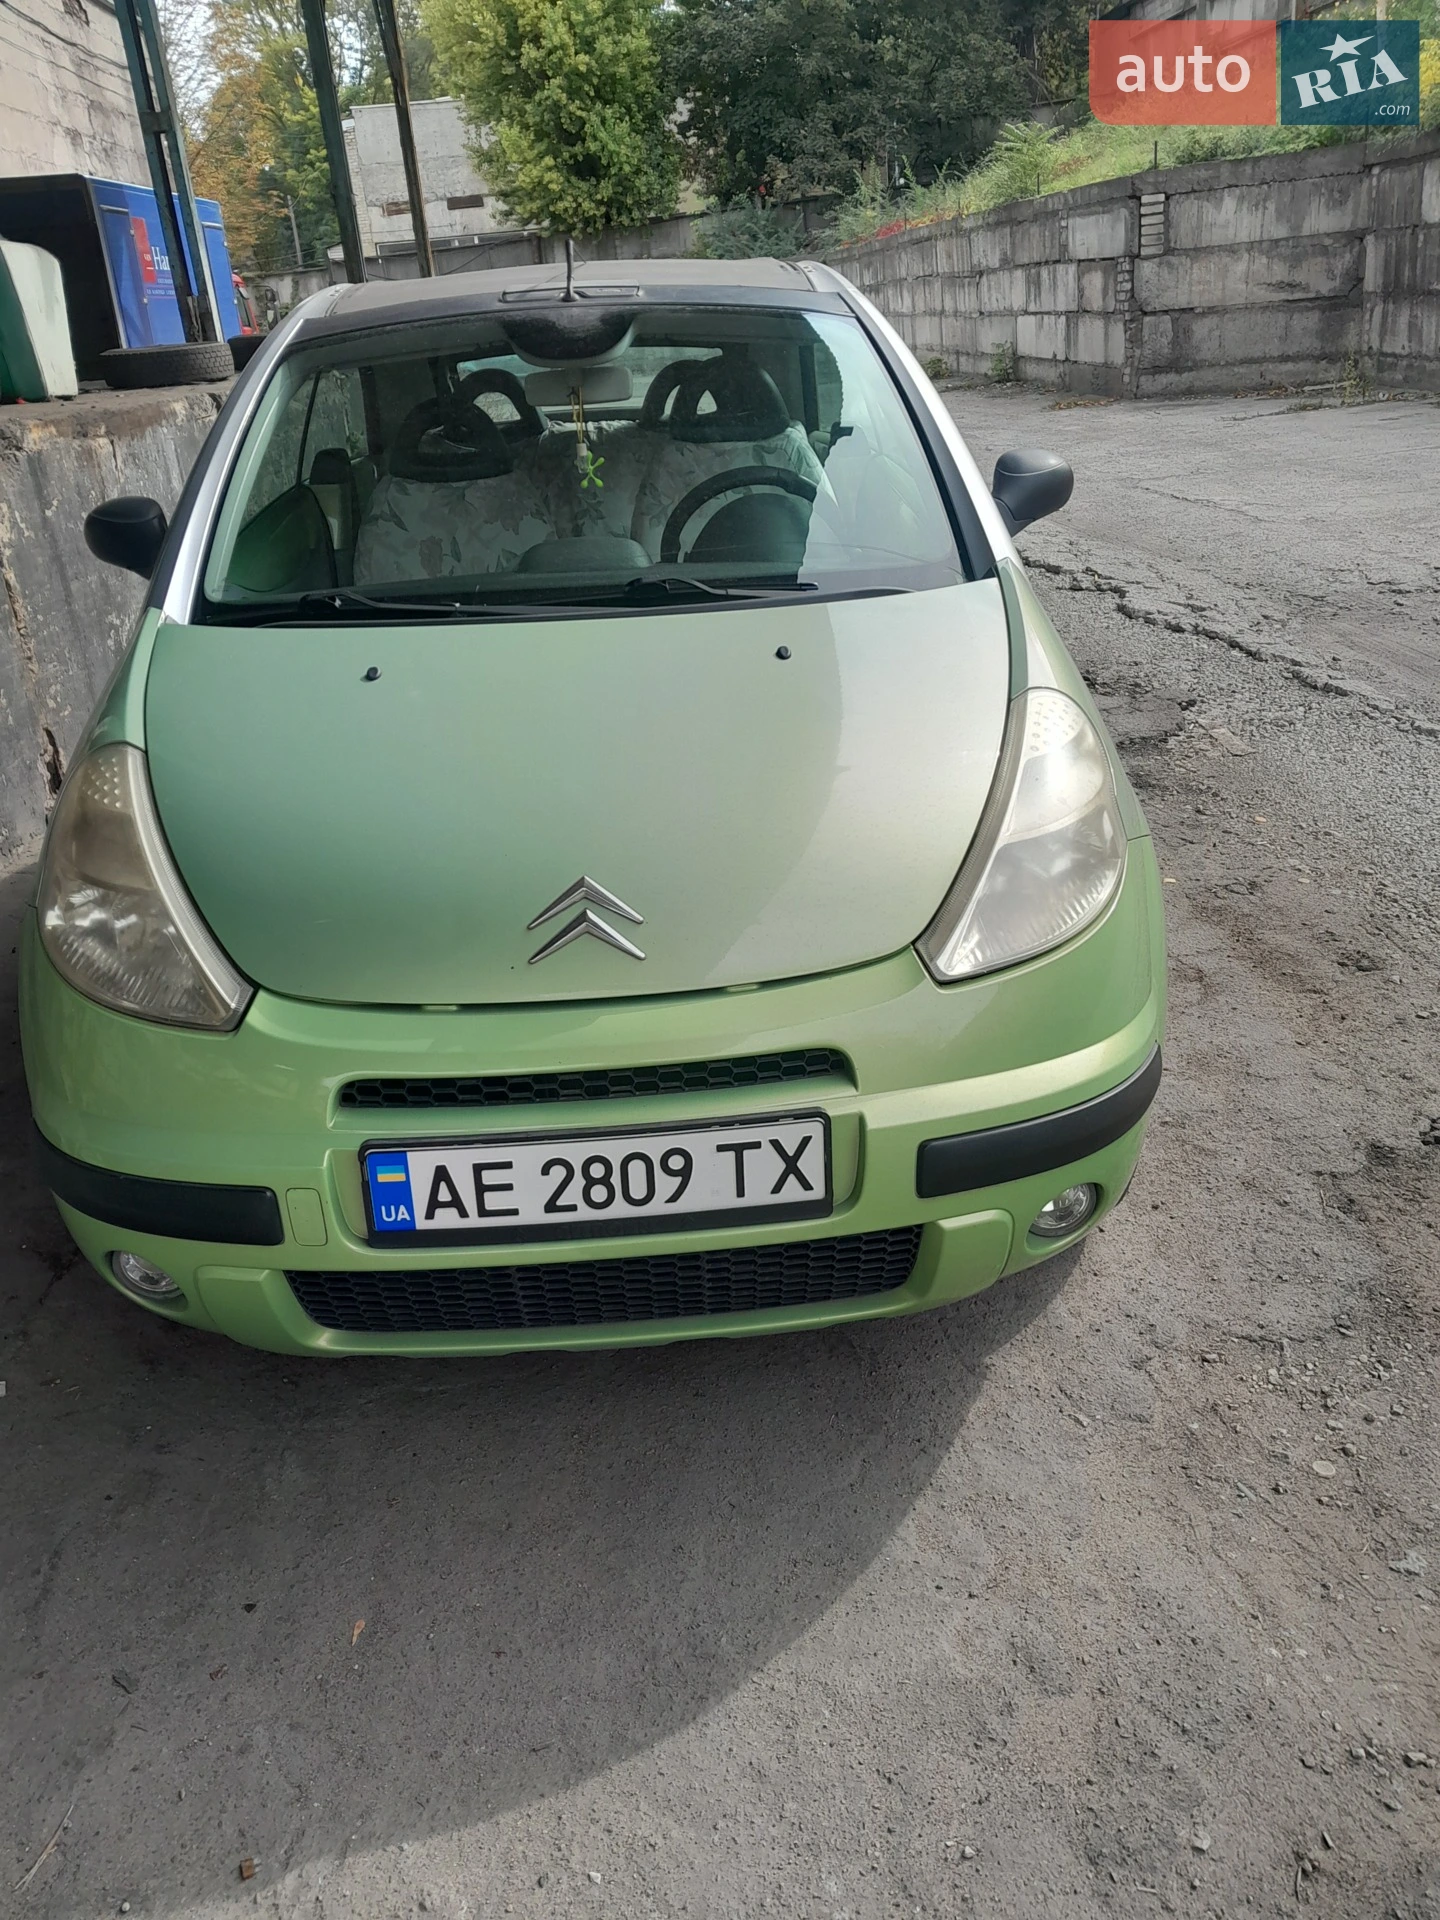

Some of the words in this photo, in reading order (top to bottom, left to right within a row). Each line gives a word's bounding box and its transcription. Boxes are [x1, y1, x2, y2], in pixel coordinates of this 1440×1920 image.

[424, 1160, 519, 1220] AE
[540, 1147, 694, 1214] 2809
[715, 1135, 815, 1198] TX
[381, 1204, 411, 1223] UA
